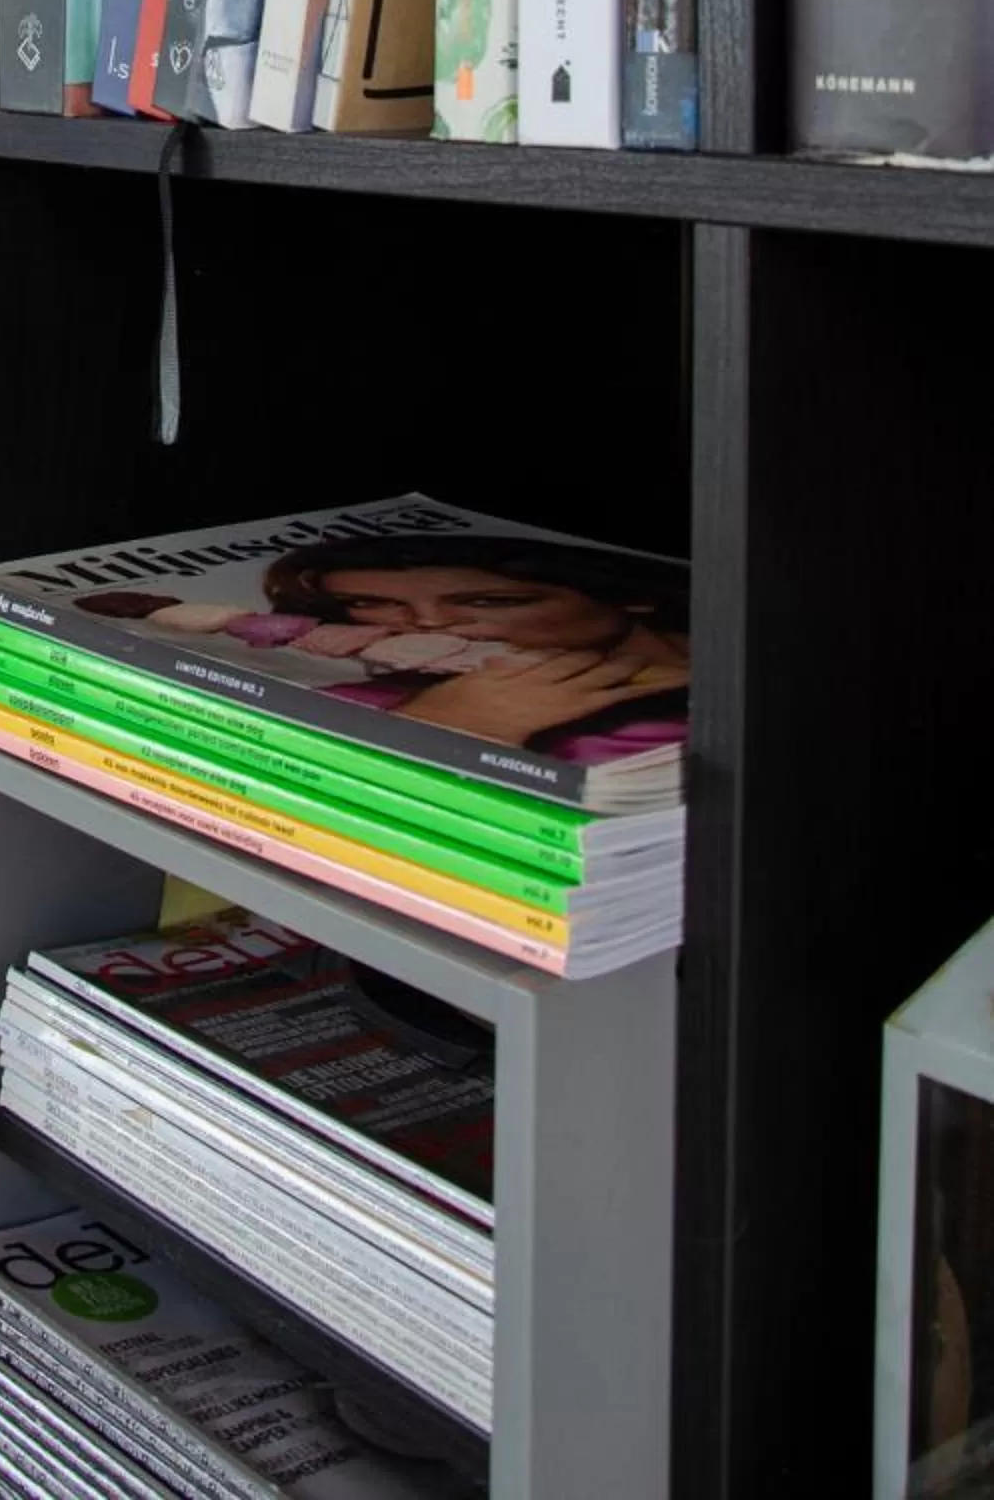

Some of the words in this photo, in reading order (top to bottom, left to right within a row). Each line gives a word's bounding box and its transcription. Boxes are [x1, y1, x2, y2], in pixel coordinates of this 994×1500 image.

[642, 55, 660, 117] KOSMOS
[815, 72, 916, 95] KÖNEMANN
[11, 507, 474, 594] Miljuschka
